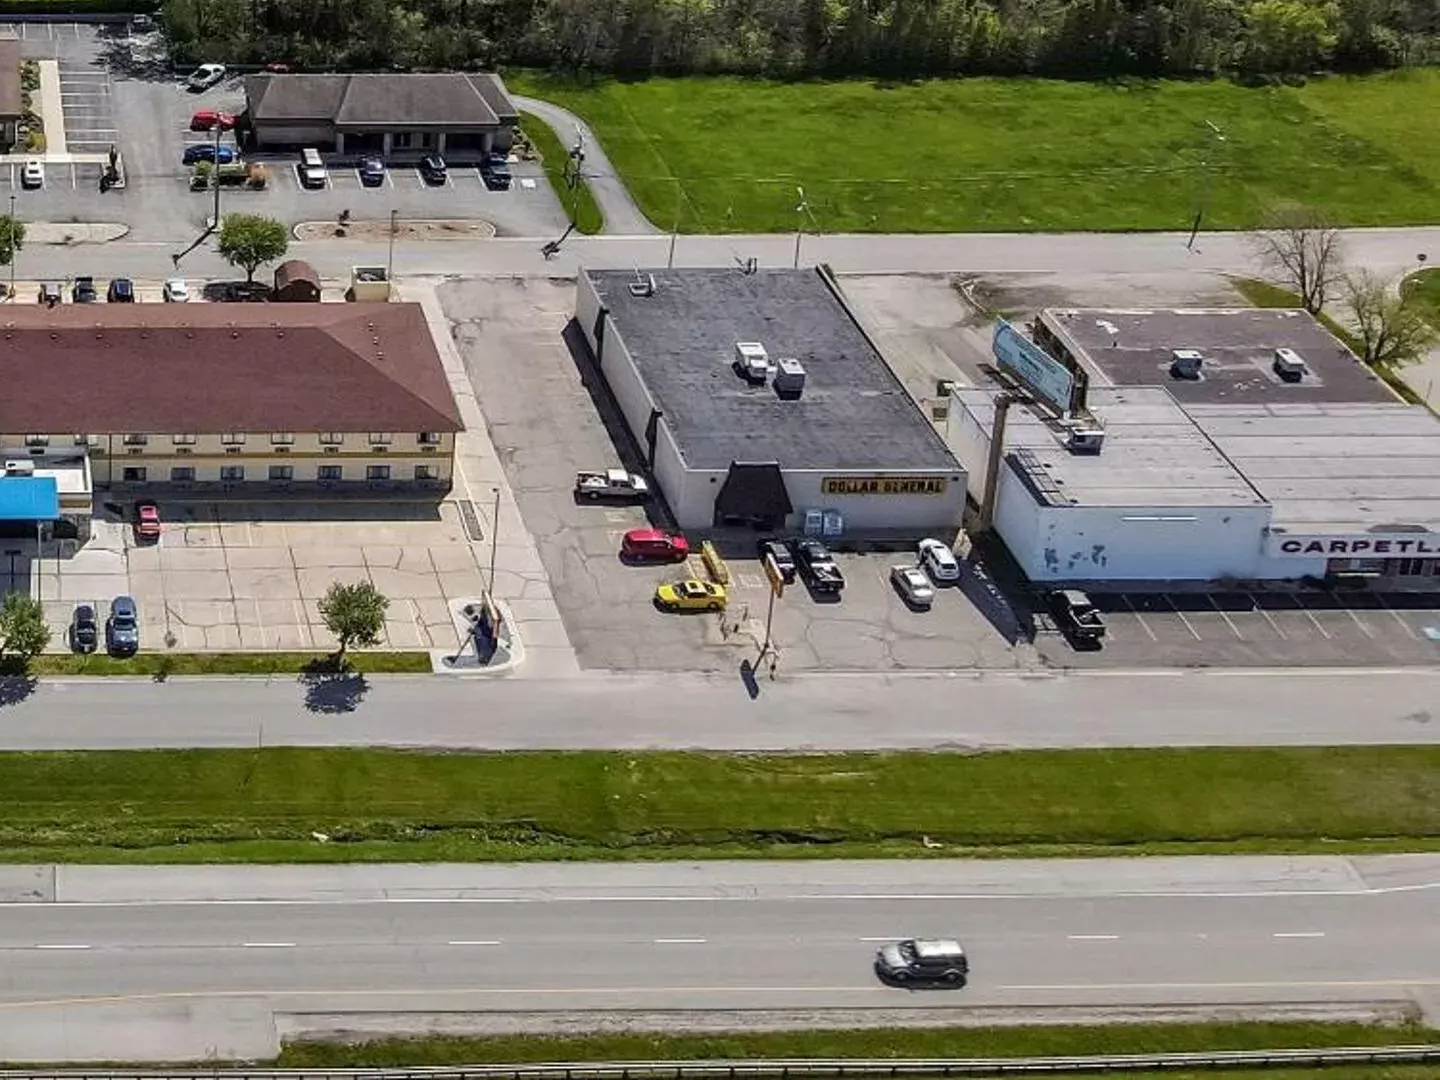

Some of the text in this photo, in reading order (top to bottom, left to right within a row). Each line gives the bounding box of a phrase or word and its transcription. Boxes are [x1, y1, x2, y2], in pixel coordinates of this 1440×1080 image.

[828, 480, 942, 493] DOLLAR GENERAL
[1281, 540, 1440, 553] CARPETL
